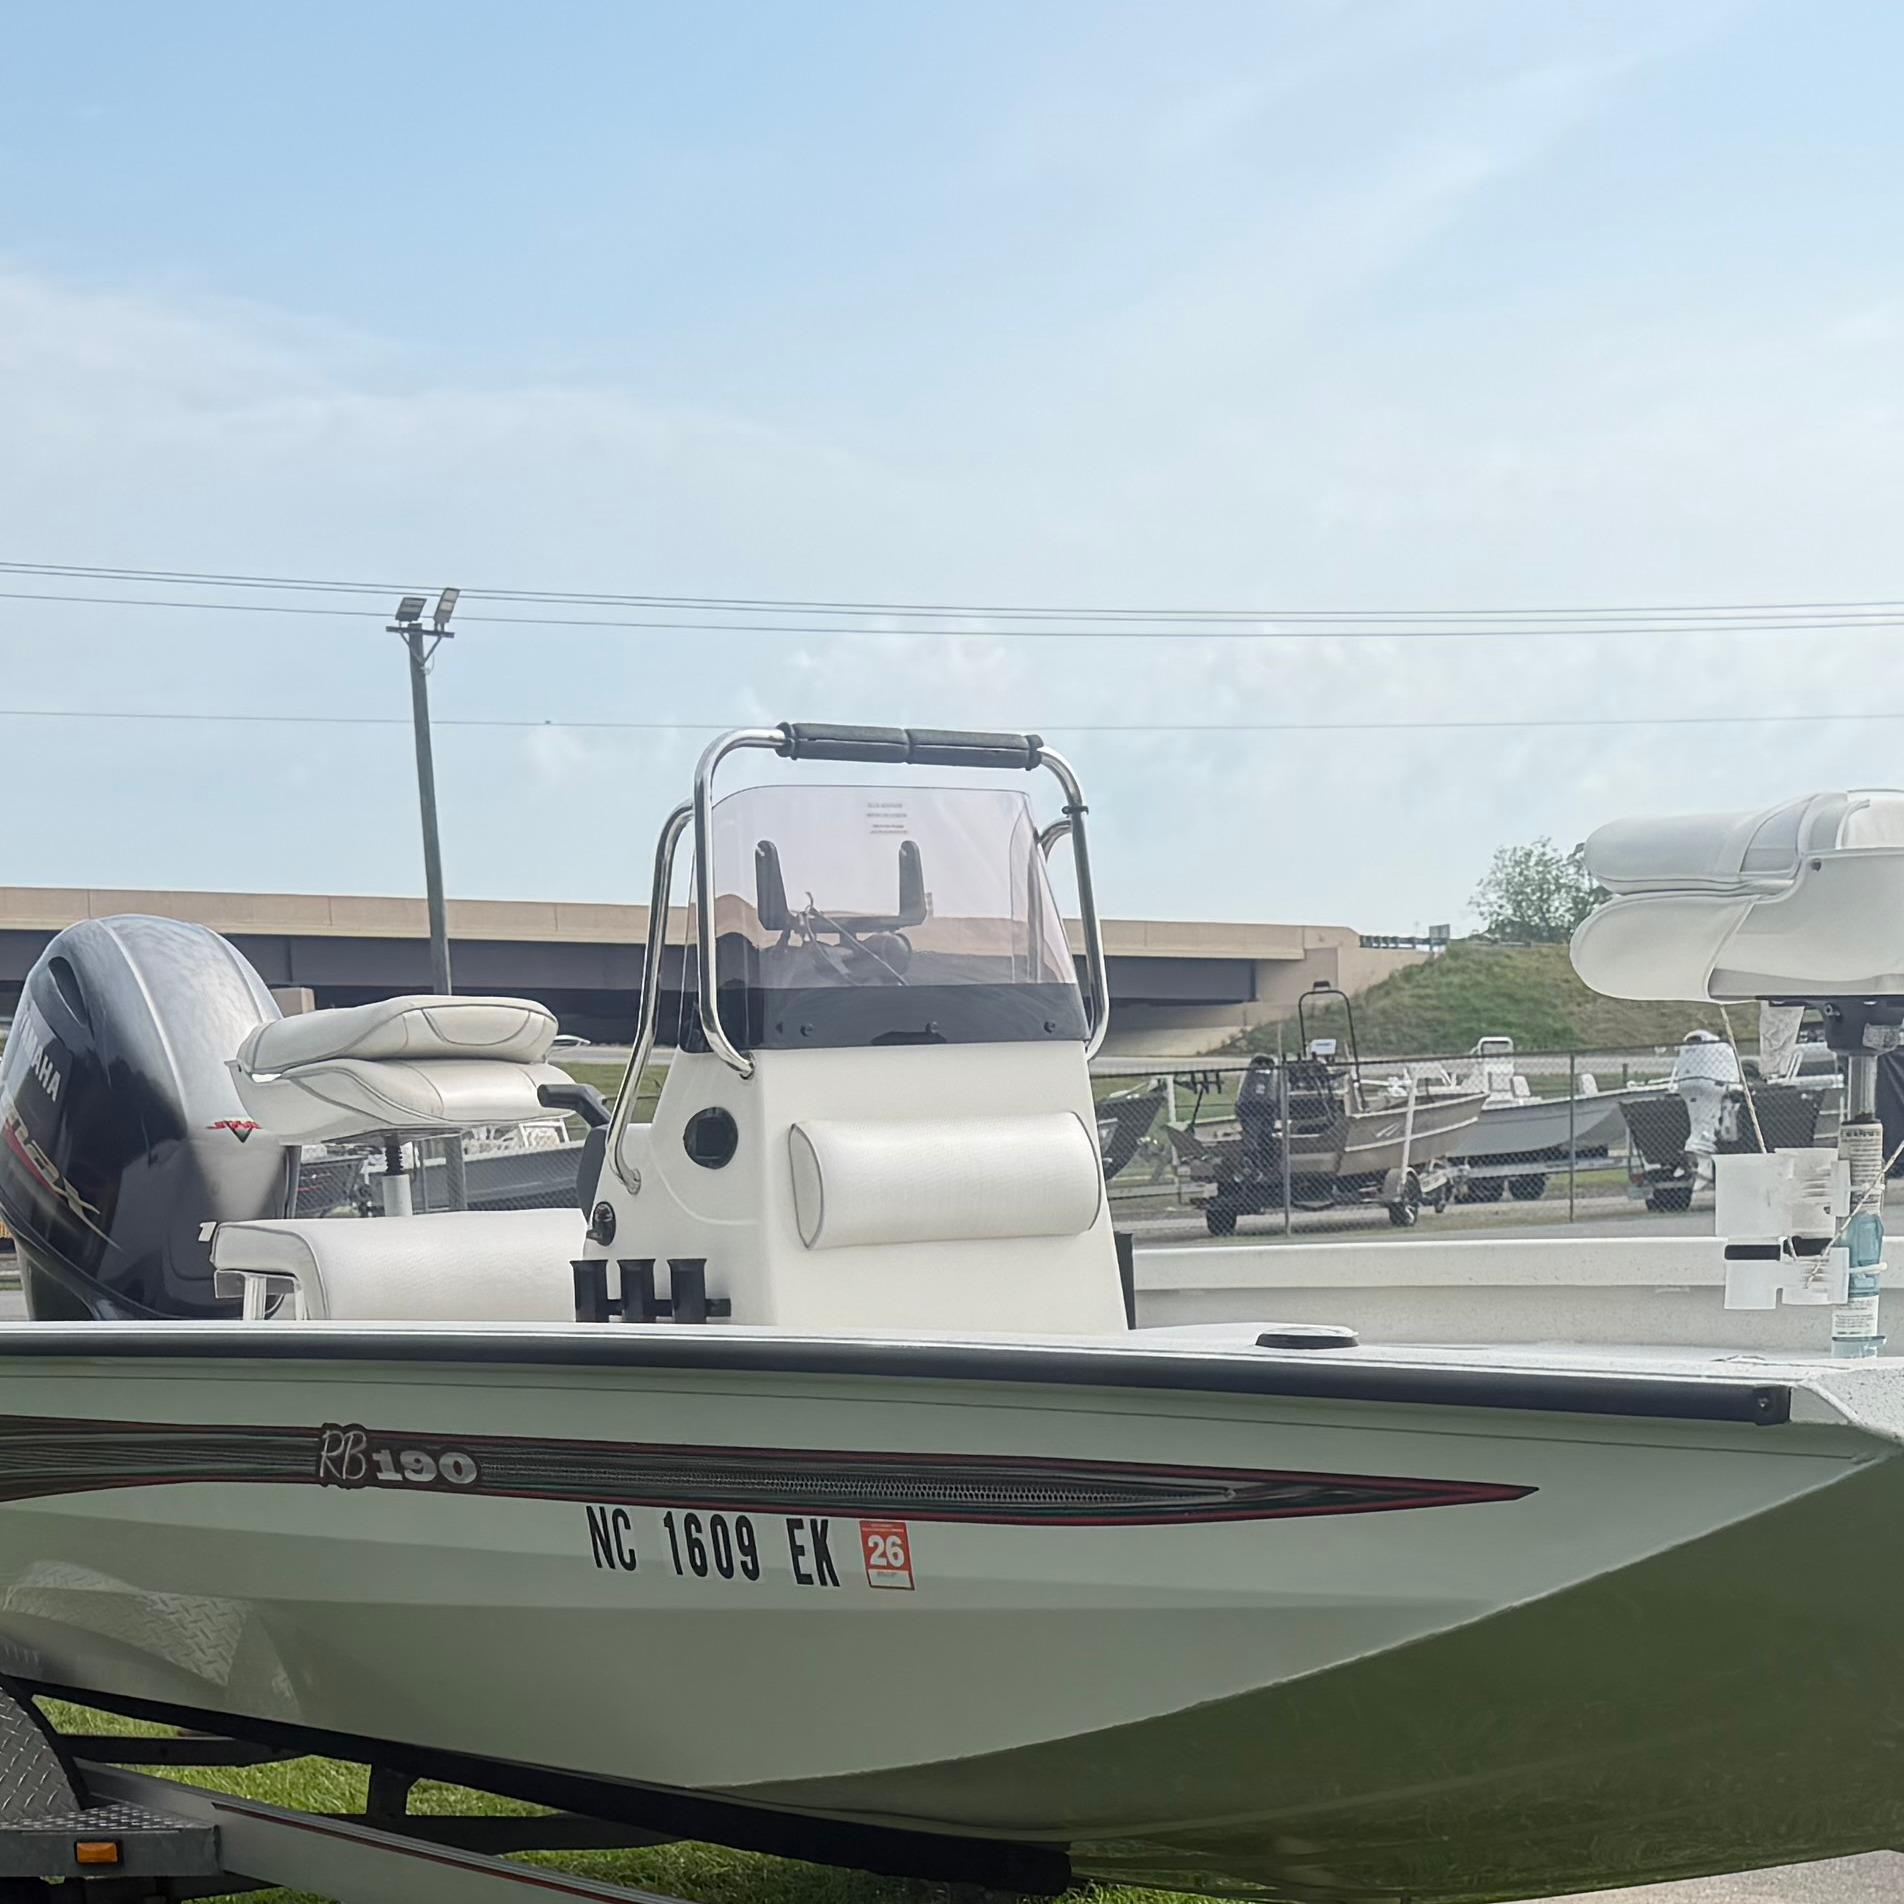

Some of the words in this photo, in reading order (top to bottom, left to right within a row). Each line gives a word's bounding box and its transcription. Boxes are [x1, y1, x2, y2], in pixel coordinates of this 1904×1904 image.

[586, 1505, 637, 1571] NC
[663, 1511, 760, 1582] 1609
[786, 1518, 840, 1587] EK
[868, 1535, 905, 1567] 26
